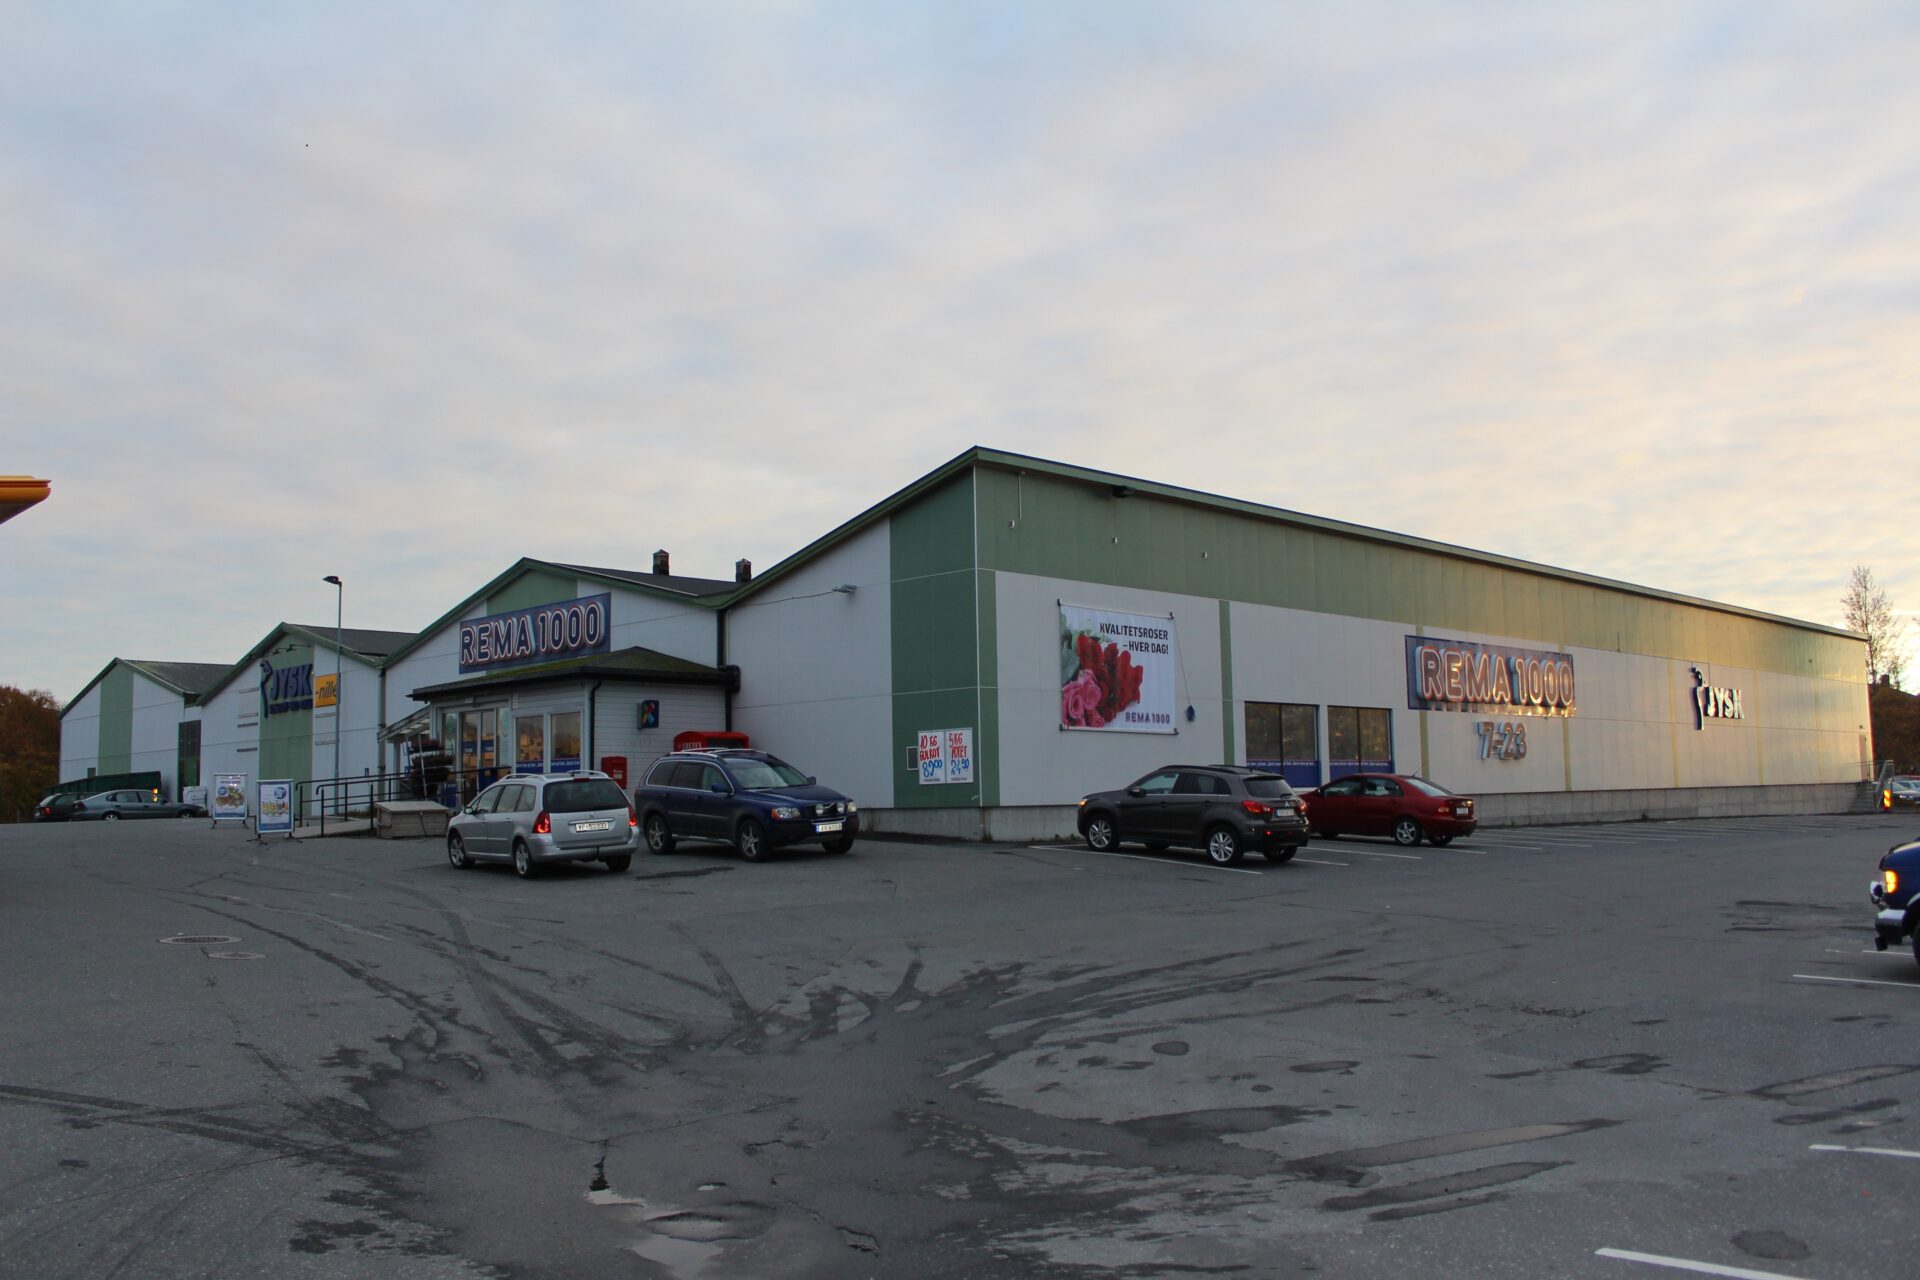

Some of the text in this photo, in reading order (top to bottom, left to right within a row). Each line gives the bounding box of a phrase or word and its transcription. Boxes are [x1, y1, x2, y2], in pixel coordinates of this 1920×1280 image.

[460, 602, 604, 665] REMA 1000
[1099, 622, 1169, 641] KVALITETSROSER
[1128, 640, 1150, 653] HVER
[1151, 642, 1169, 655] DAG!
[270, 664, 313, 700] JYSK
[1415, 646, 1574, 706] REMA 1000
[1125, 712, 1170, 724] REMA 1000
[1706, 686, 1744, 719] JYSK
[1476, 721, 1527, 760] 7-23
